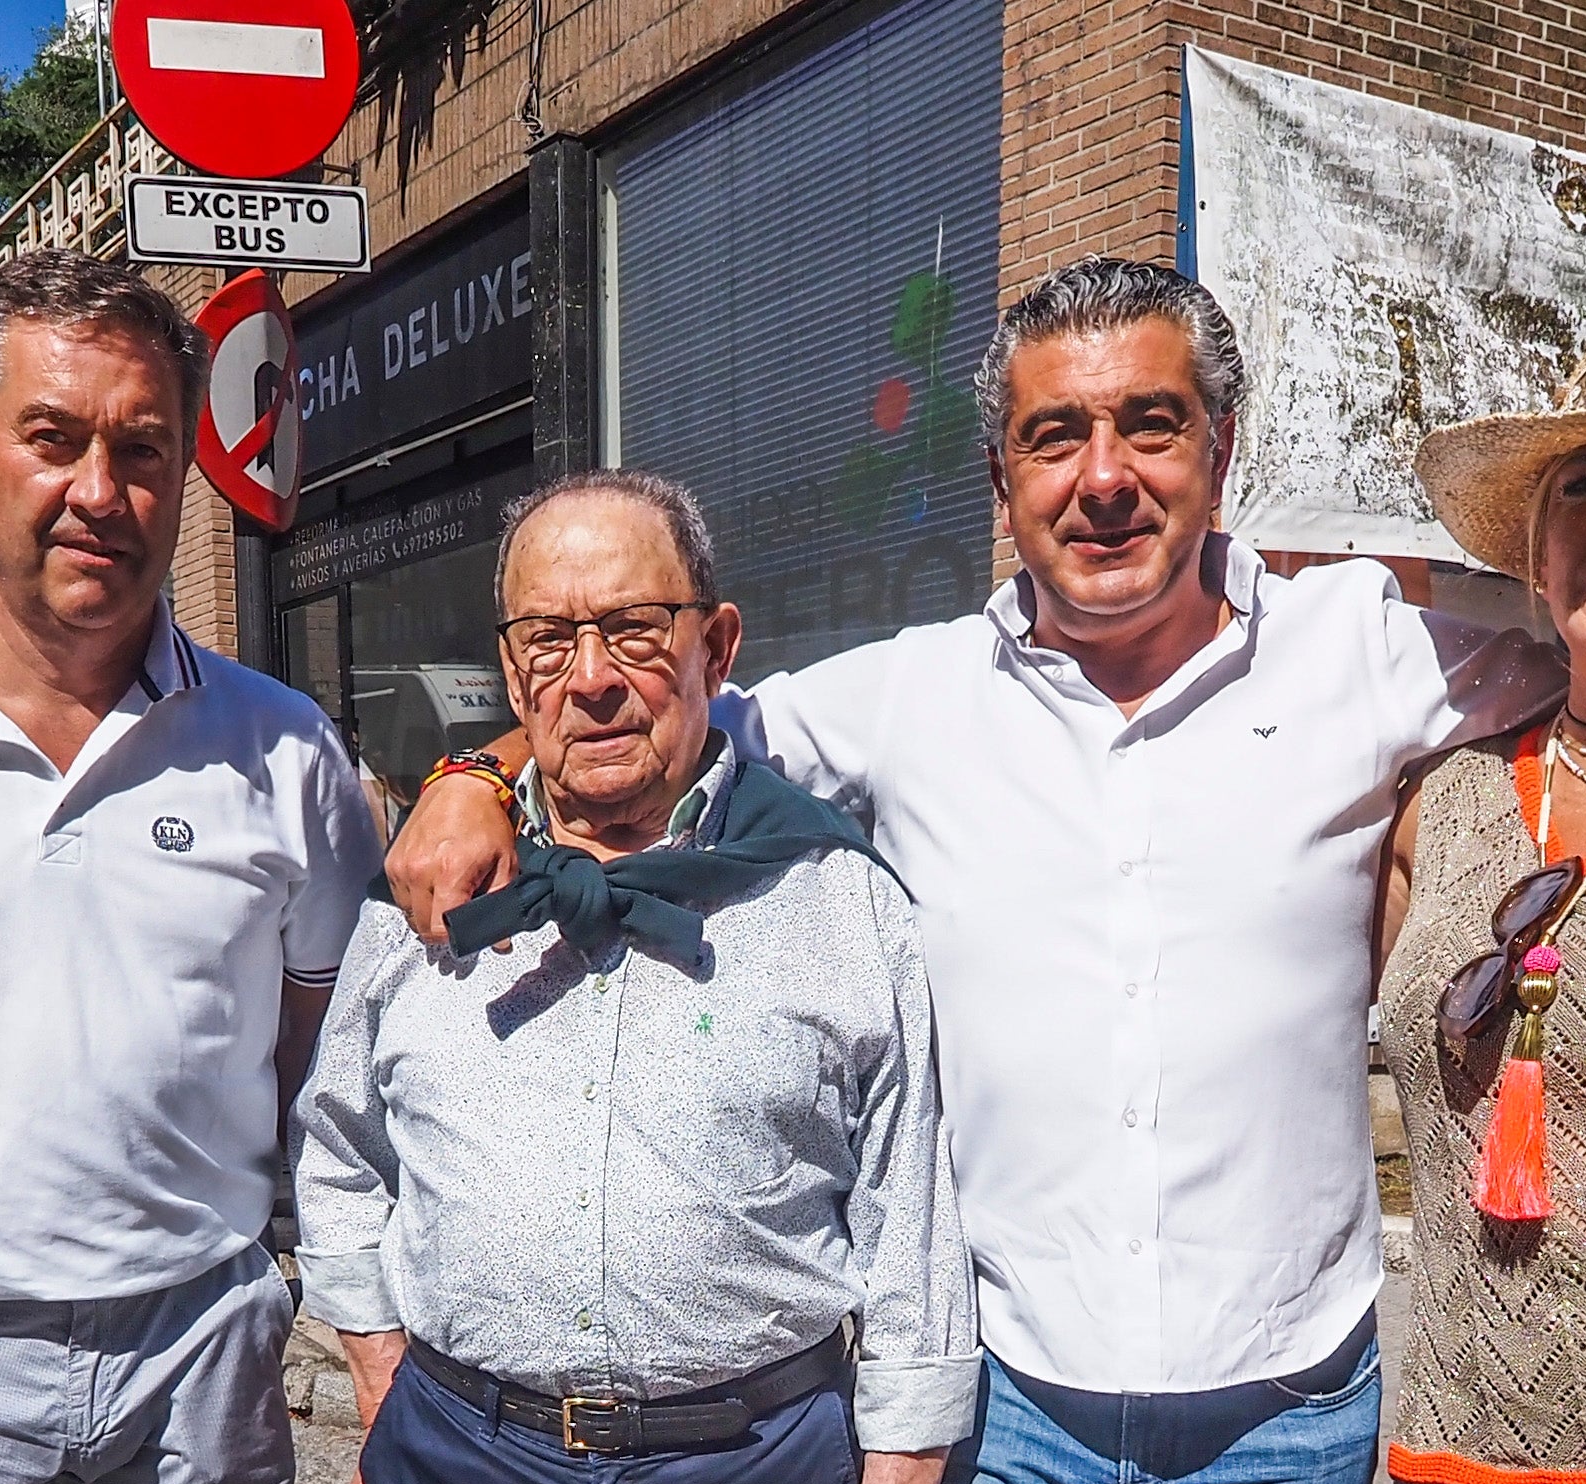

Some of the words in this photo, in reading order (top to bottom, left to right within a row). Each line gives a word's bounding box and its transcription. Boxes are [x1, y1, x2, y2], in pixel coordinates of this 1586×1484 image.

[165, 190, 330, 224] EXCEPTO
[215, 224, 287, 254] BUS
[298, 345, 362, 421] CHA
[383, 251, 533, 381] DELUXE
[363, 502, 442, 545] CALEFACCIÓN
[445, 498, 453, 515] Y
[457, 487, 482, 511] GAS
[295, 566, 330, 591] AVISOS
[332, 561, 339, 578] Y
[342, 545, 386, 575] AVERÍAS
[402, 520, 465, 556] 697295502
